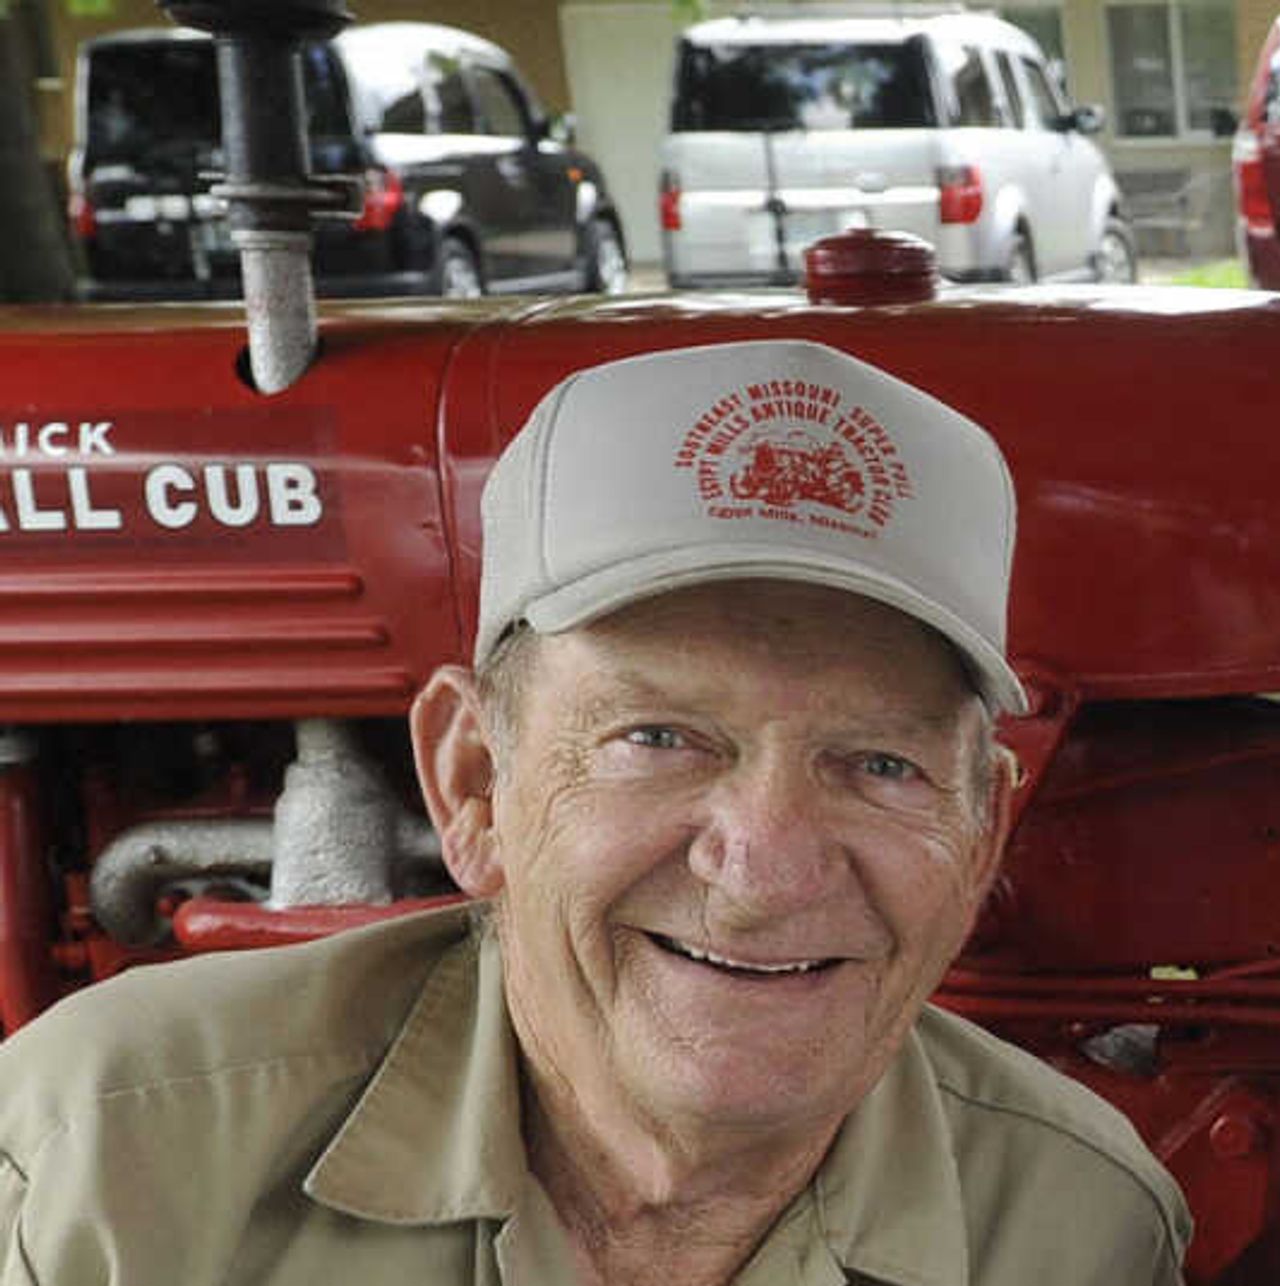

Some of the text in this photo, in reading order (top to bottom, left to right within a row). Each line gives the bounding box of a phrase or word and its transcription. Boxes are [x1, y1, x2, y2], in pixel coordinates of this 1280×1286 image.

[746, 379, 842, 408] MISSOURI
[0, 421, 115, 457] ICK
[706, 414, 751, 455] MILLS
[750, 399, 834, 426] ANTIQUE
[833, 417, 892, 487] TRACTOR
[0, 463, 323, 530] LL CUB
